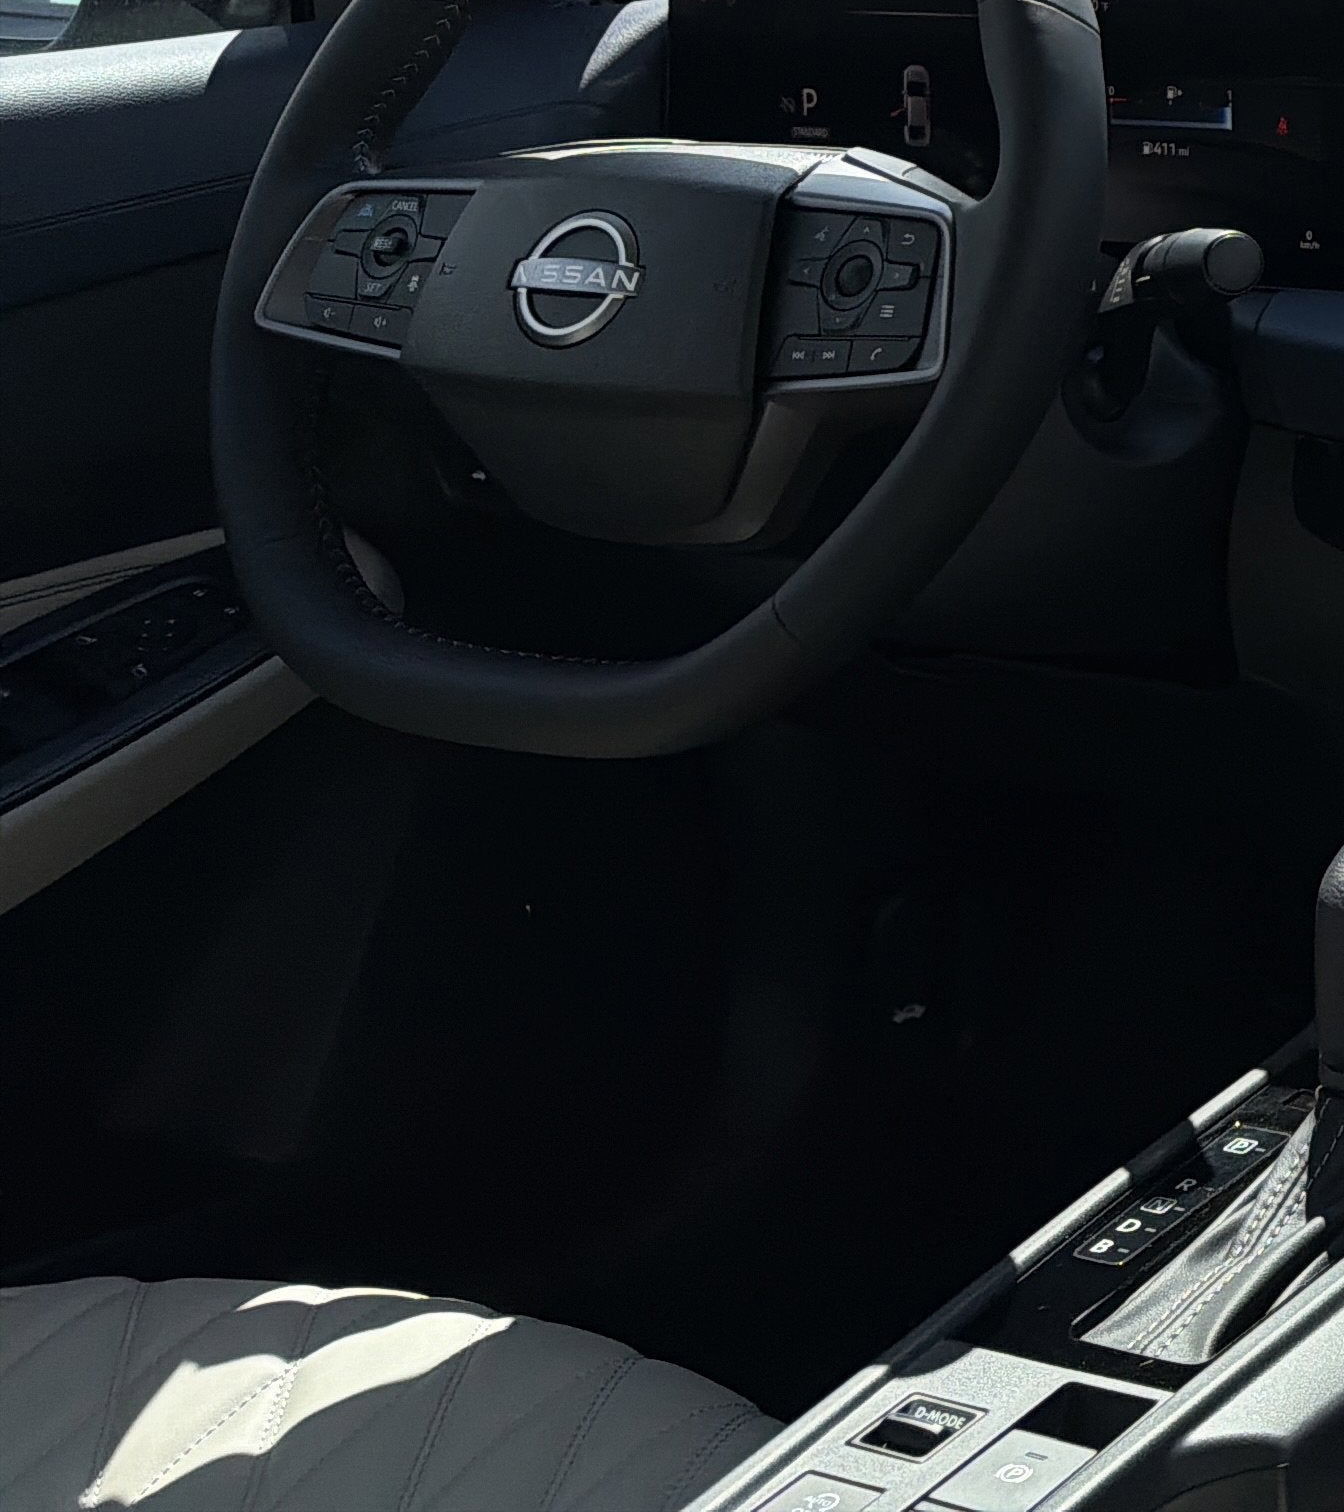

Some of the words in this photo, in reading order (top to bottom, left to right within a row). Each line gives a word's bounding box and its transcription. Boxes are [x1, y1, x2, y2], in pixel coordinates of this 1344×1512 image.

[801, 88, 818, 117] P
[1154, 142, 1176, 156] 411
[511, 264, 640, 292] NSSAN
[1175, 1178, 1197, 1191] R
[1115, 1218, 1141, 1232] D
[914, 1406, 966, 1429] D-MODE
